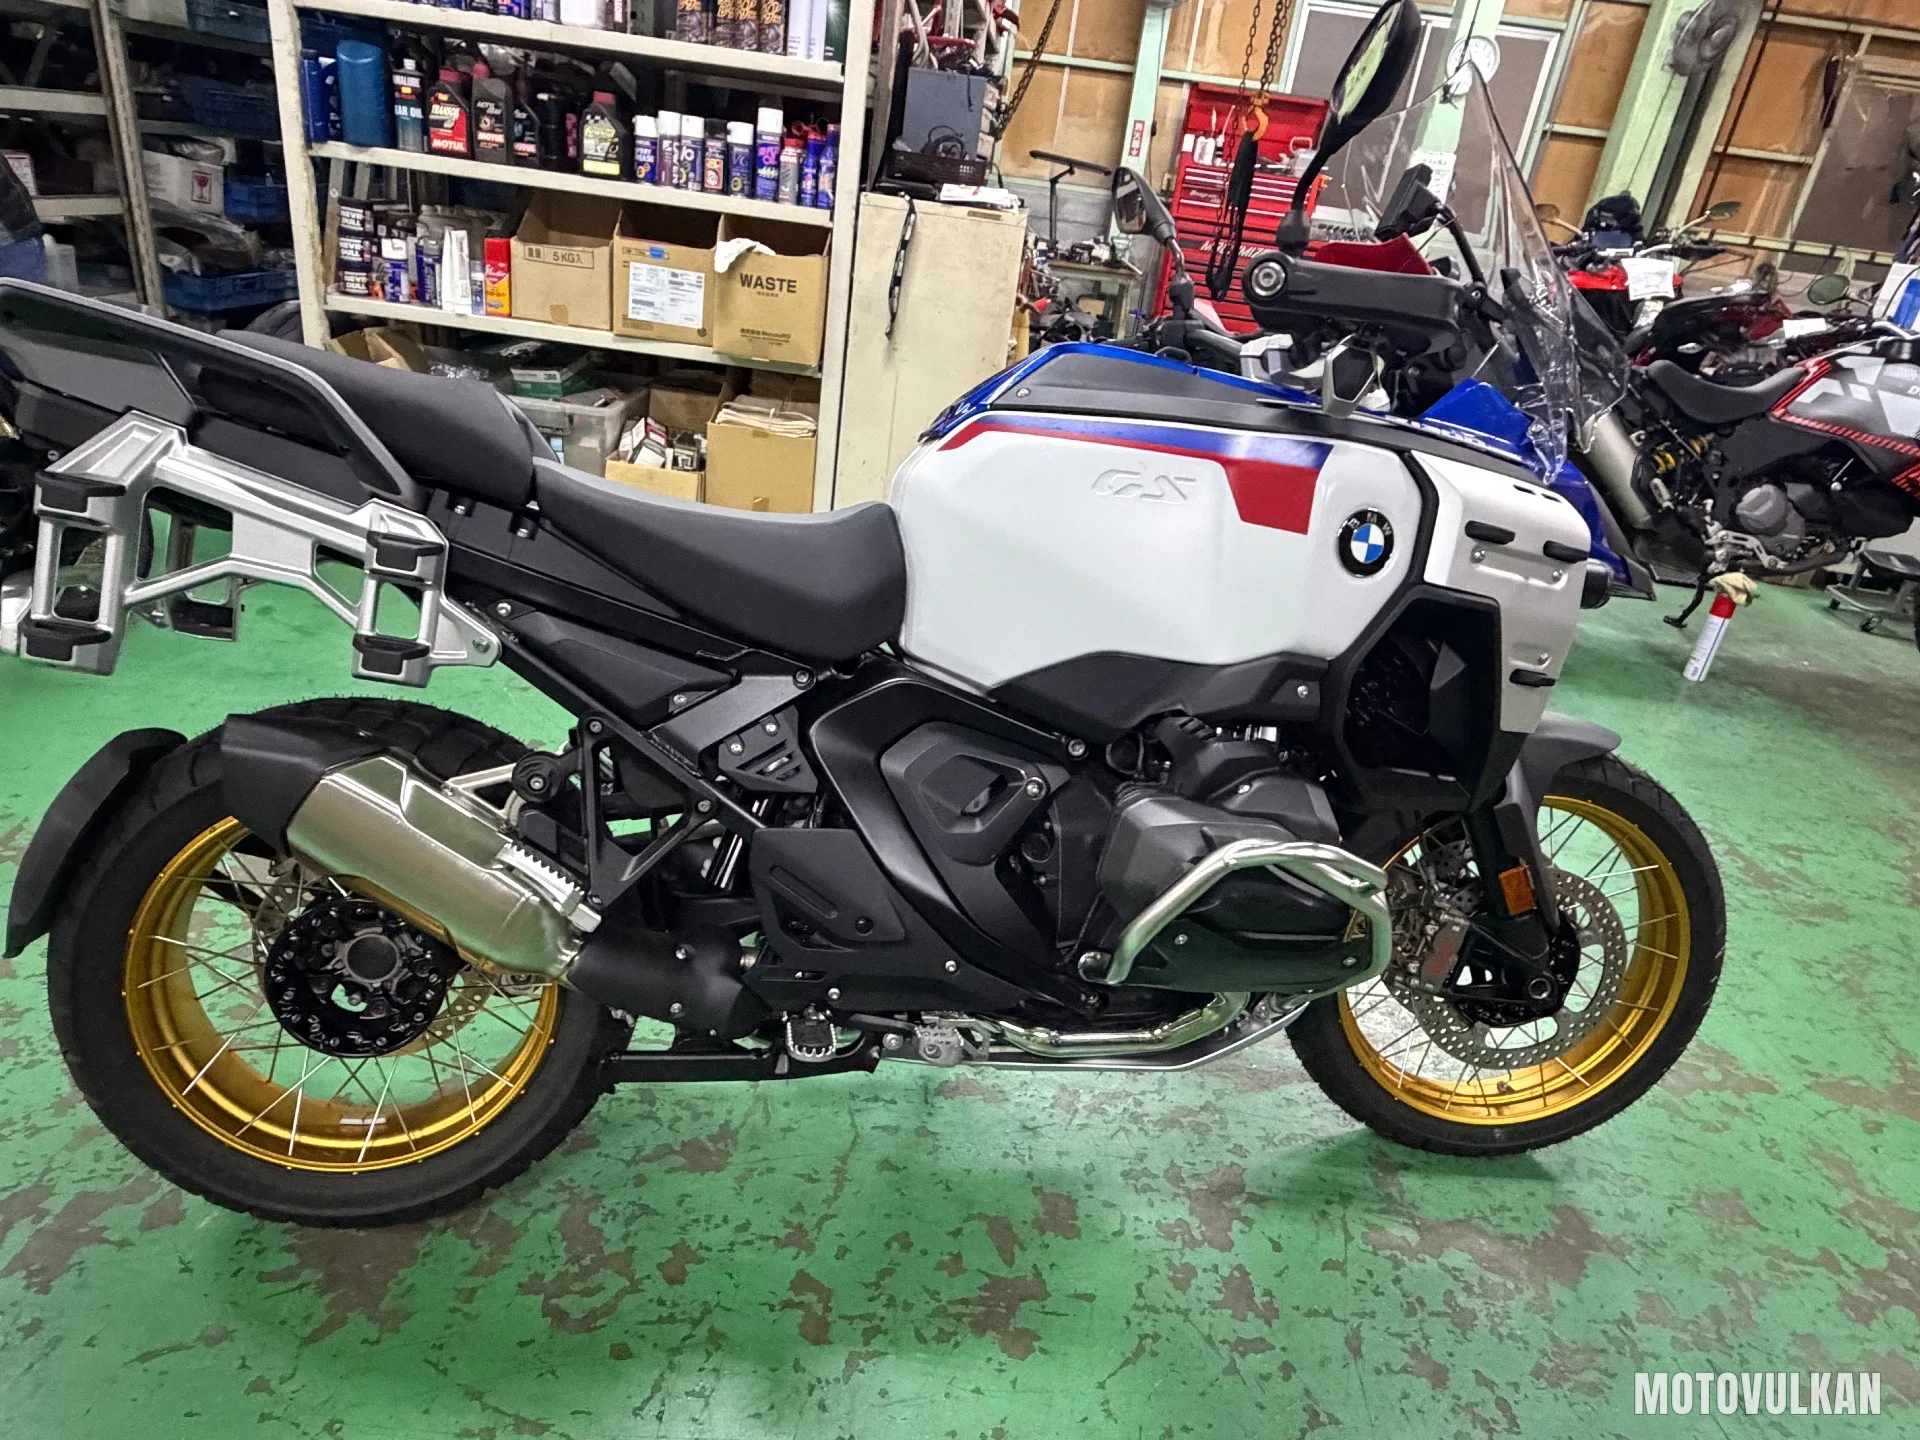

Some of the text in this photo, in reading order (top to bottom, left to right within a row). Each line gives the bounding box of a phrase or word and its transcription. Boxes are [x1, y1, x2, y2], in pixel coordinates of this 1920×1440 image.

[431, 139, 465, 152] MOTUL
[740, 272, 797, 294] WASTE
[1348, 512, 1392, 536] BMW
